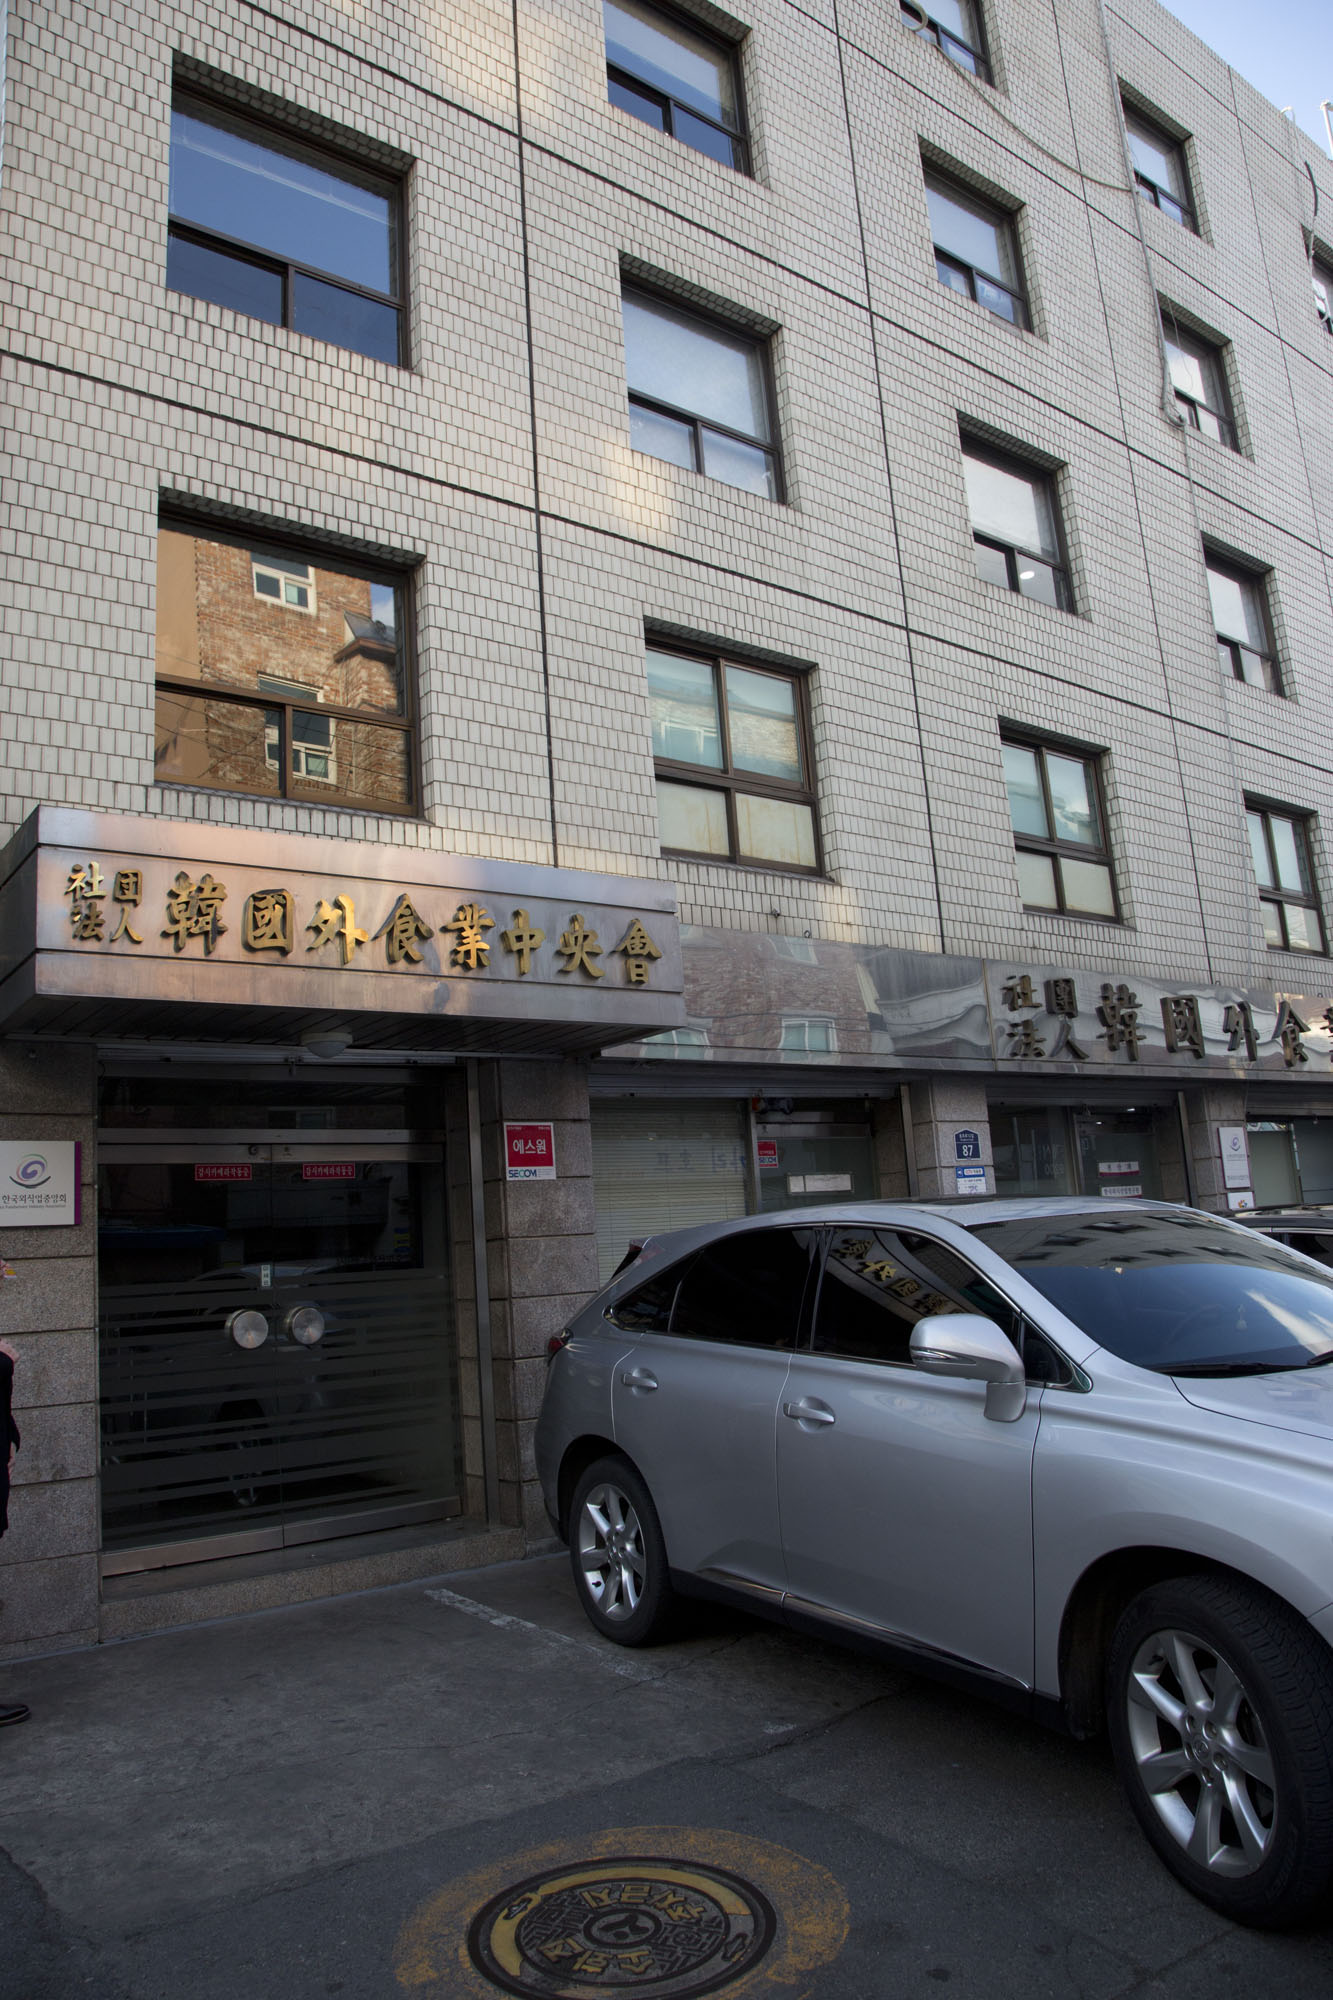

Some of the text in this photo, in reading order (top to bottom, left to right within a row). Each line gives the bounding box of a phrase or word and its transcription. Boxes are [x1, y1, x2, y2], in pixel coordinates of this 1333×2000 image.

[160, 870, 663, 985] 韓國外食業中央會
[512, 1138, 548, 1155] 에스원
[962, 1144, 974, 1157] 87
[508, 1168, 537, 1178] SECOM
[2, 1193, 67, 1205] 한국외식업중앙회
